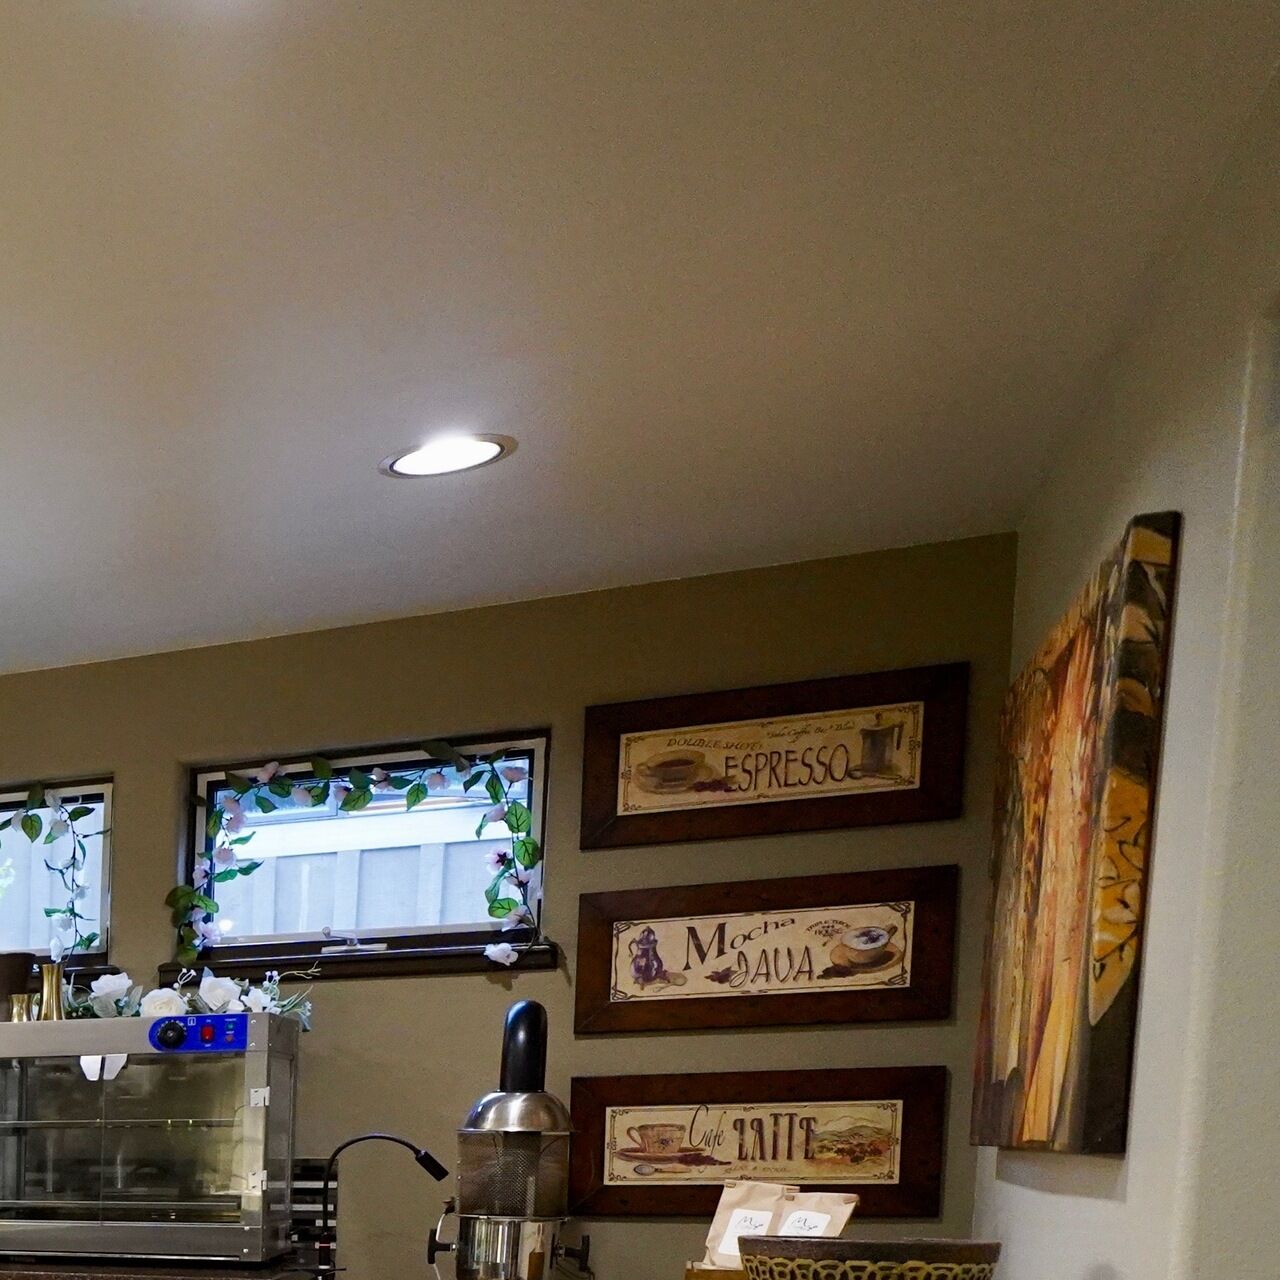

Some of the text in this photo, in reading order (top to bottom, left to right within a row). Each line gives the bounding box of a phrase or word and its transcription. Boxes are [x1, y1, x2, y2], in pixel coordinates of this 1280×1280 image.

[724, 743, 849, 792] ESPRESSO
[682, 918, 796, 971] Mocha
[729, 945, 813, 988] JAVA
[733, 1112, 818, 1161] LATTE
